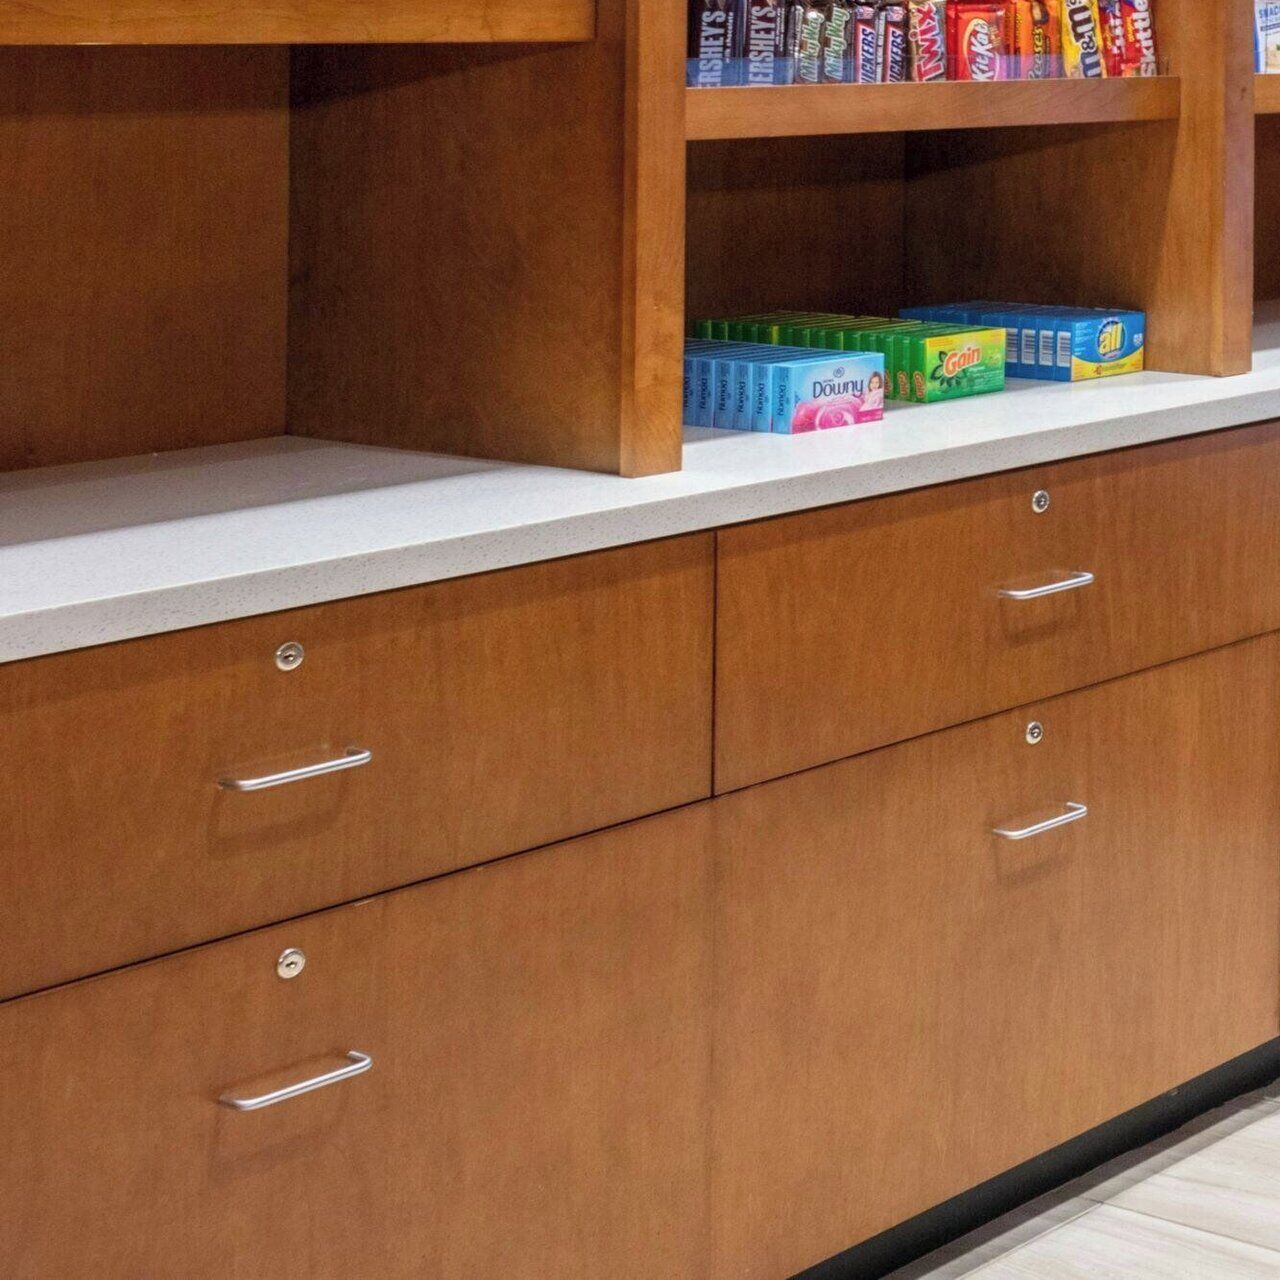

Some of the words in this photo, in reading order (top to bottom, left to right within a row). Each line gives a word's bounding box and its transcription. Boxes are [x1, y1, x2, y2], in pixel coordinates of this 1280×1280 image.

[749, 6, 776, 85] ERSHEY'S
[1099, 321, 1125, 357] all
[943, 345, 981, 376] Gain
[812, 379, 864, 400] Downy
